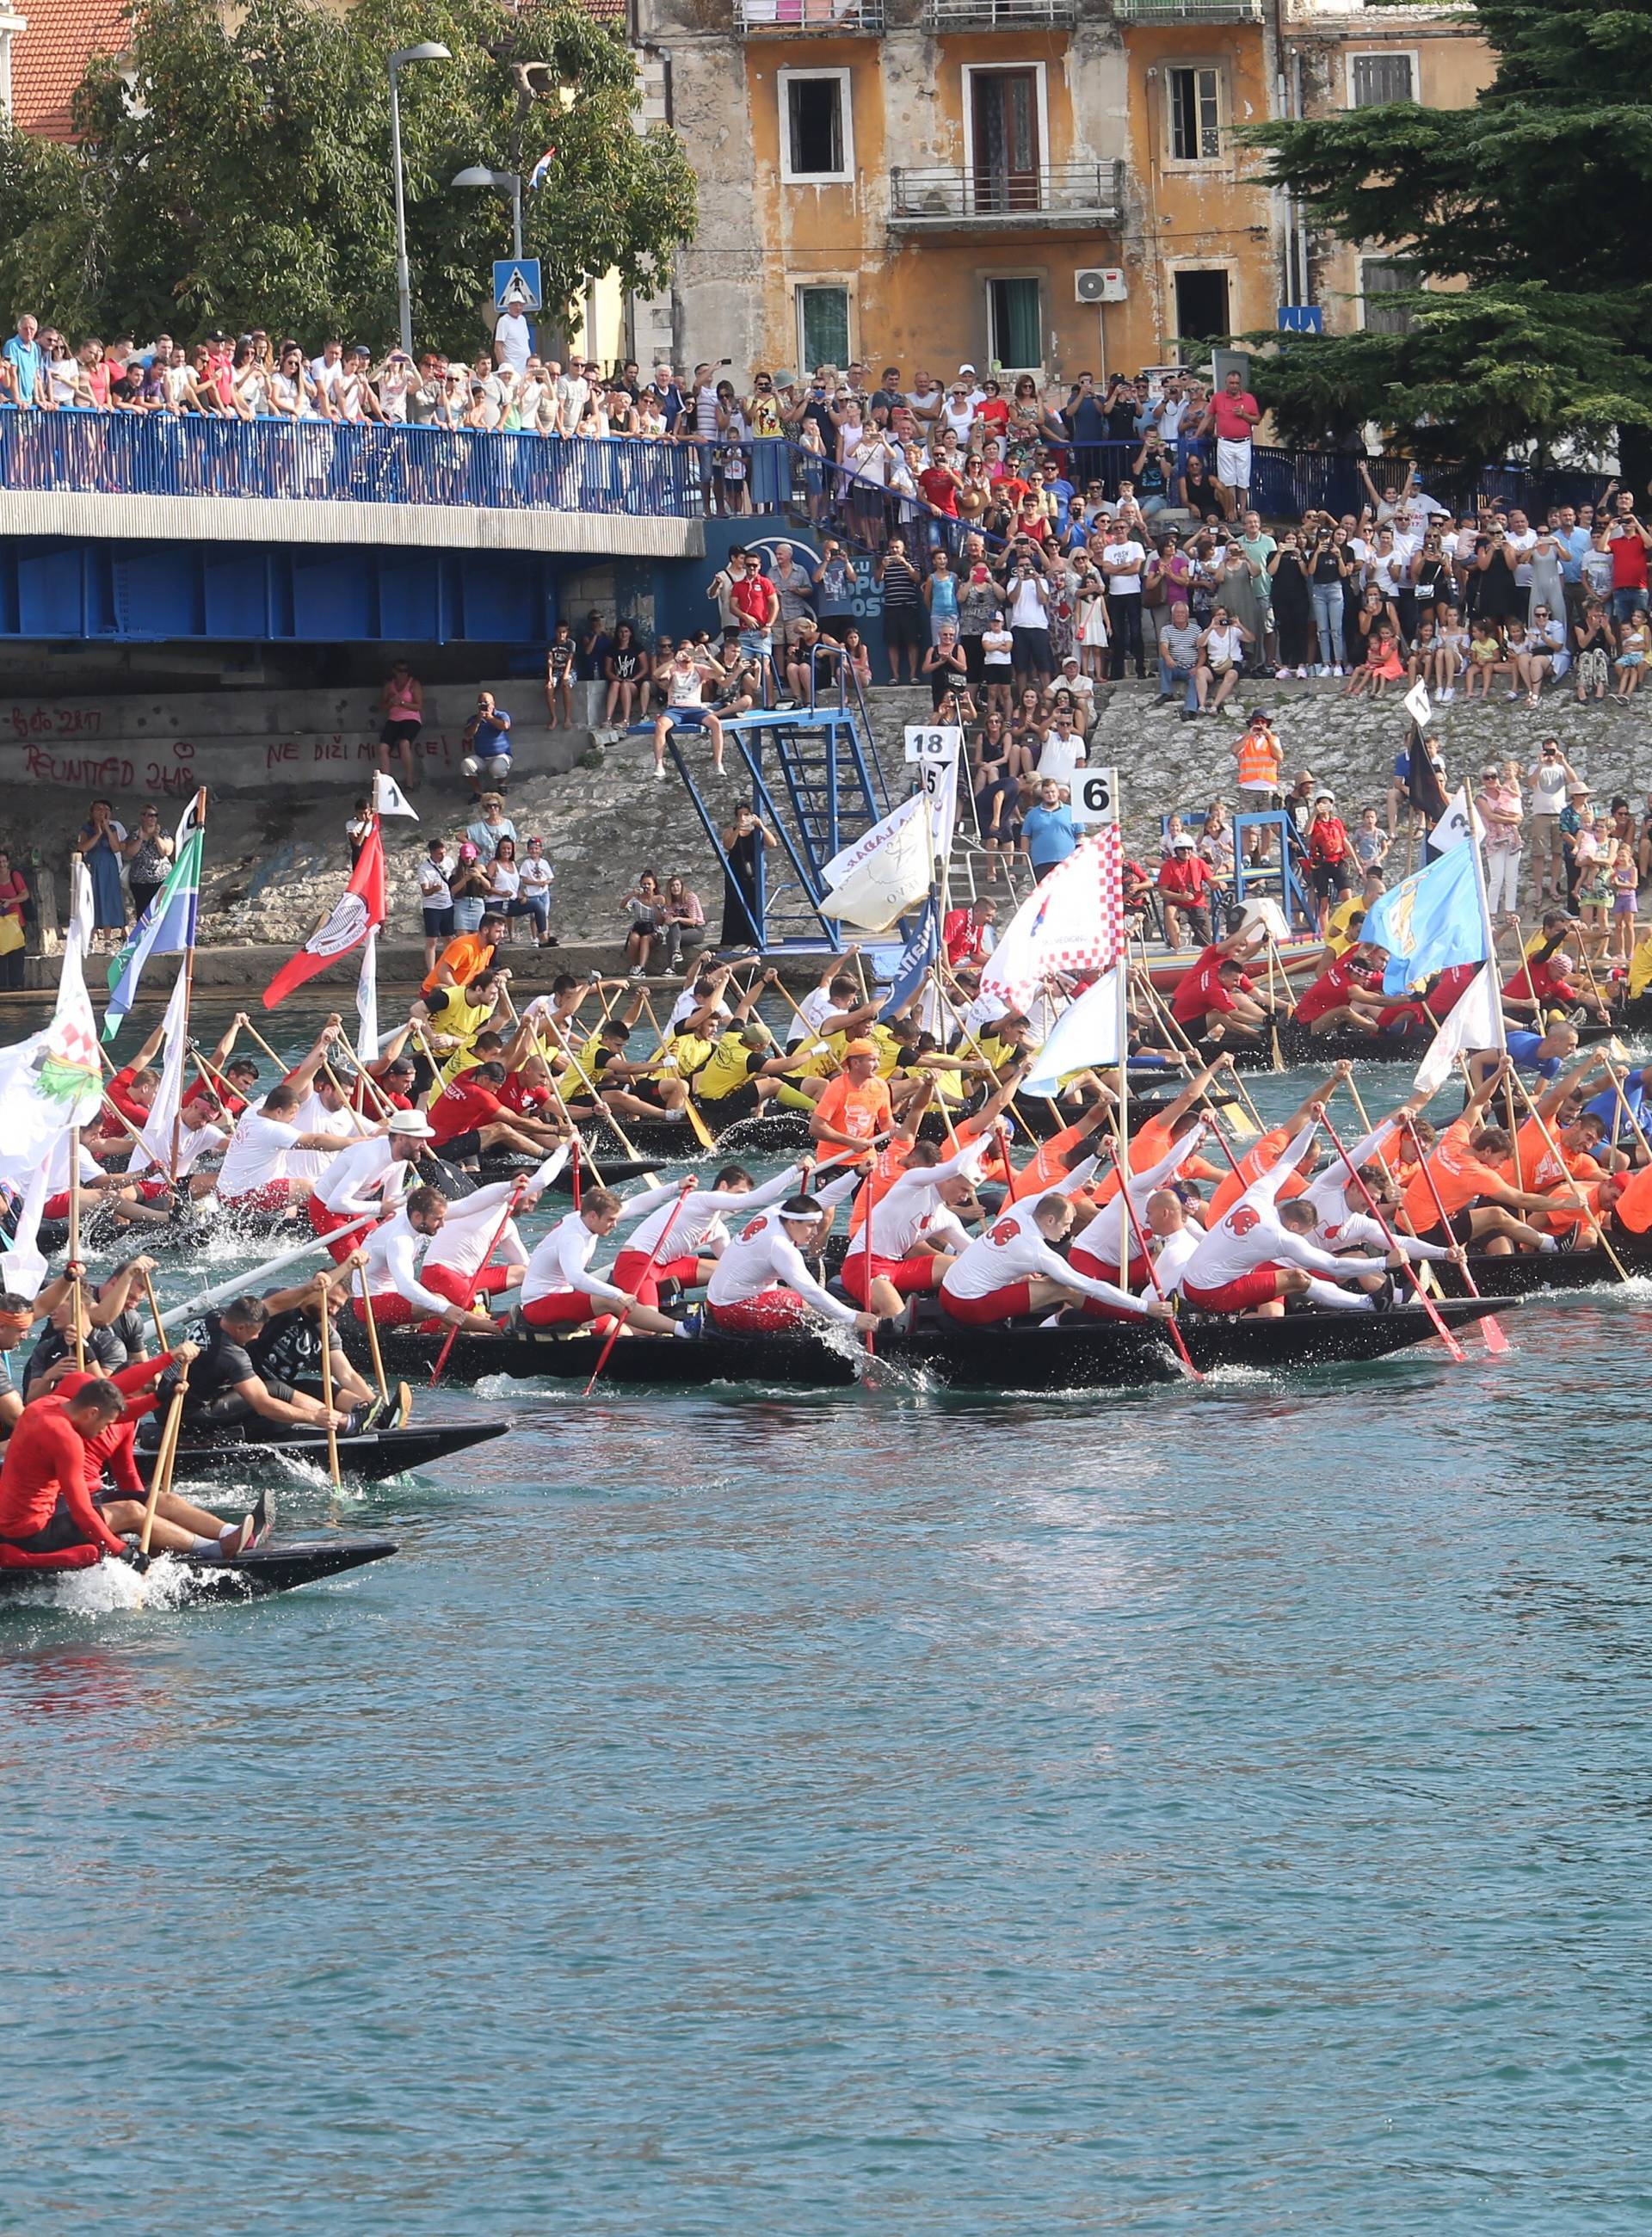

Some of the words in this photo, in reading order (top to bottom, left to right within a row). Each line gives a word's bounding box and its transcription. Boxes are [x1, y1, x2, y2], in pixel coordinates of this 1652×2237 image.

[266, 742, 299, 769] NE
[314, 736, 348, 761] DIŽI
[357, 742, 375, 760] MI
[913, 733, 943, 754] 18
[22, 743, 134, 787] REUNITED
[1083, 778, 1110, 811] 6
